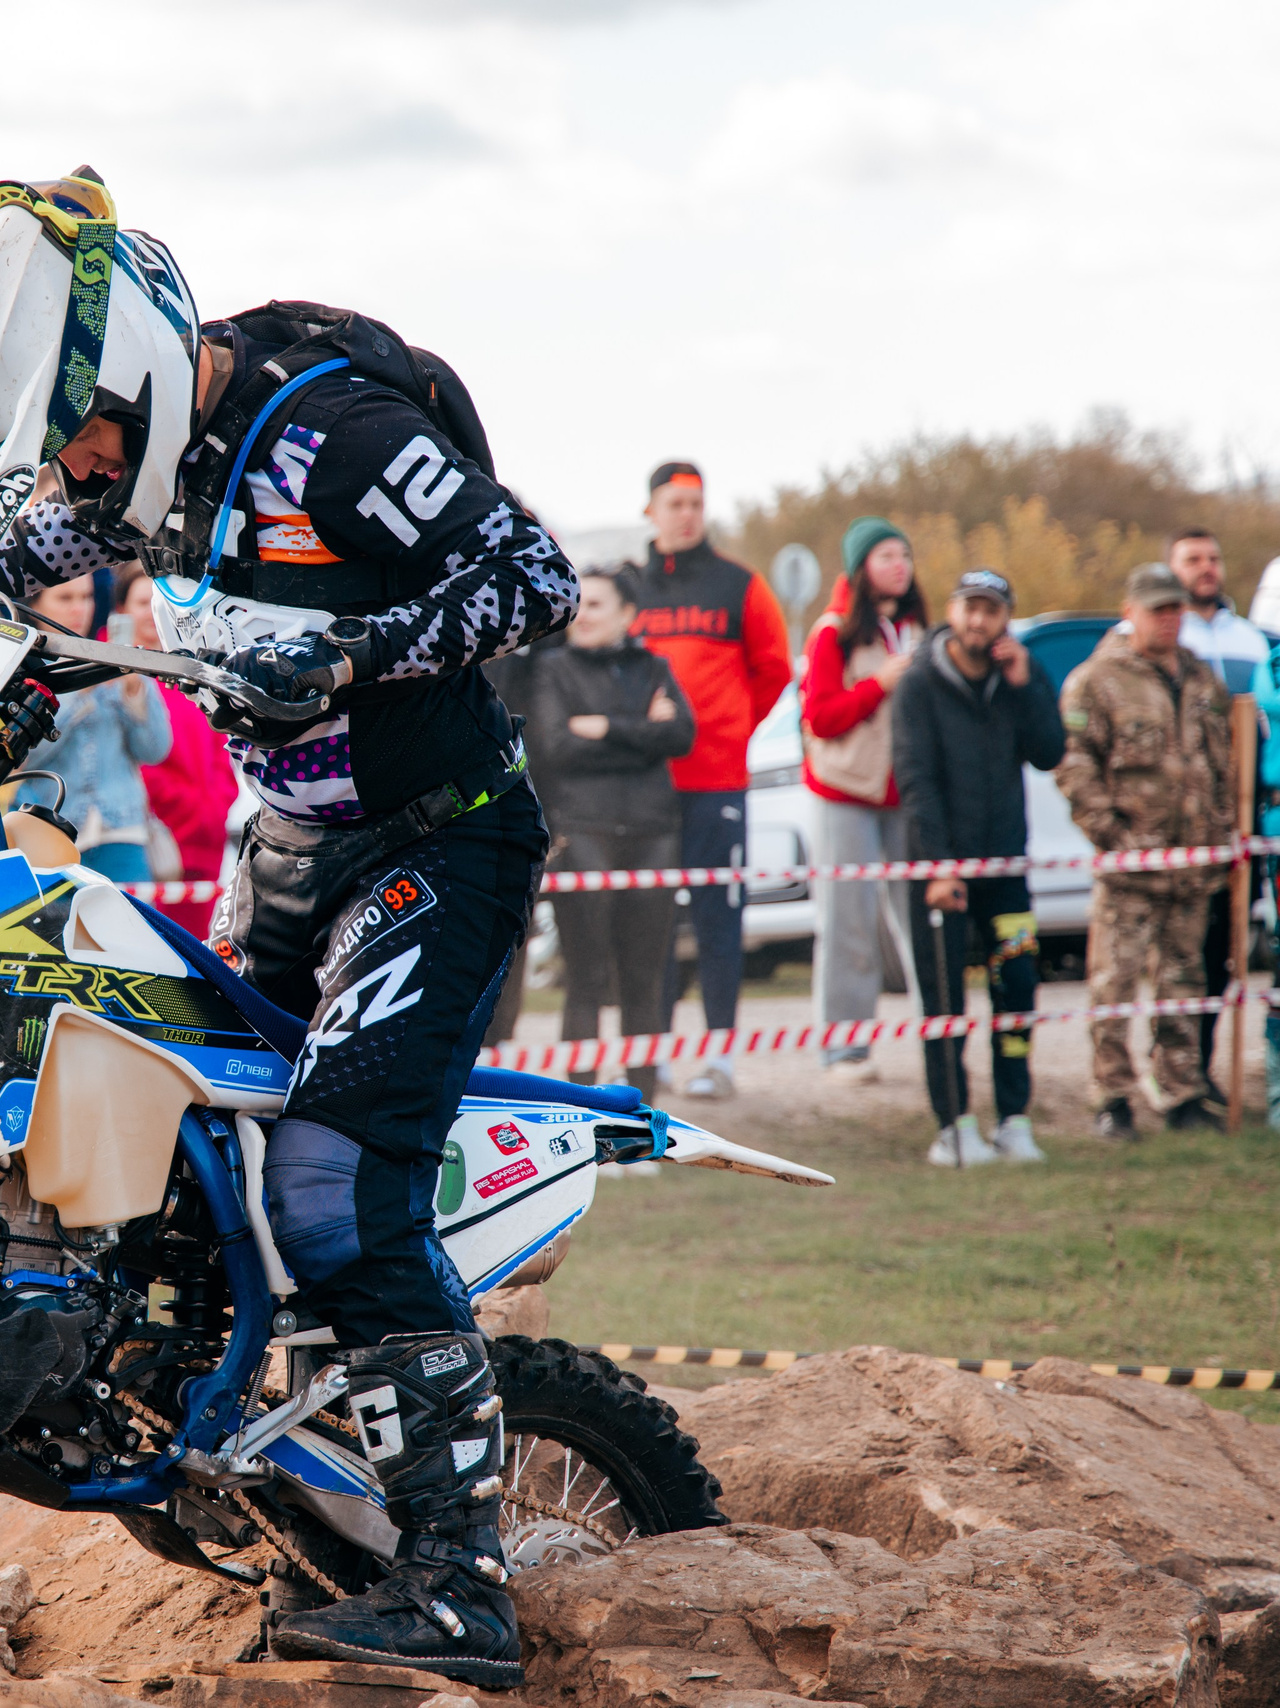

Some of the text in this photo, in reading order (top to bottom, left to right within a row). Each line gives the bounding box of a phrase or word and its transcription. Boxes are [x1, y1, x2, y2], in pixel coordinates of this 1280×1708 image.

[356, 435, 466, 548] 12
[384, 880, 418, 910] 93
[162, 1027, 206, 1045] THOR
[540, 1113, 583, 1123] 300
